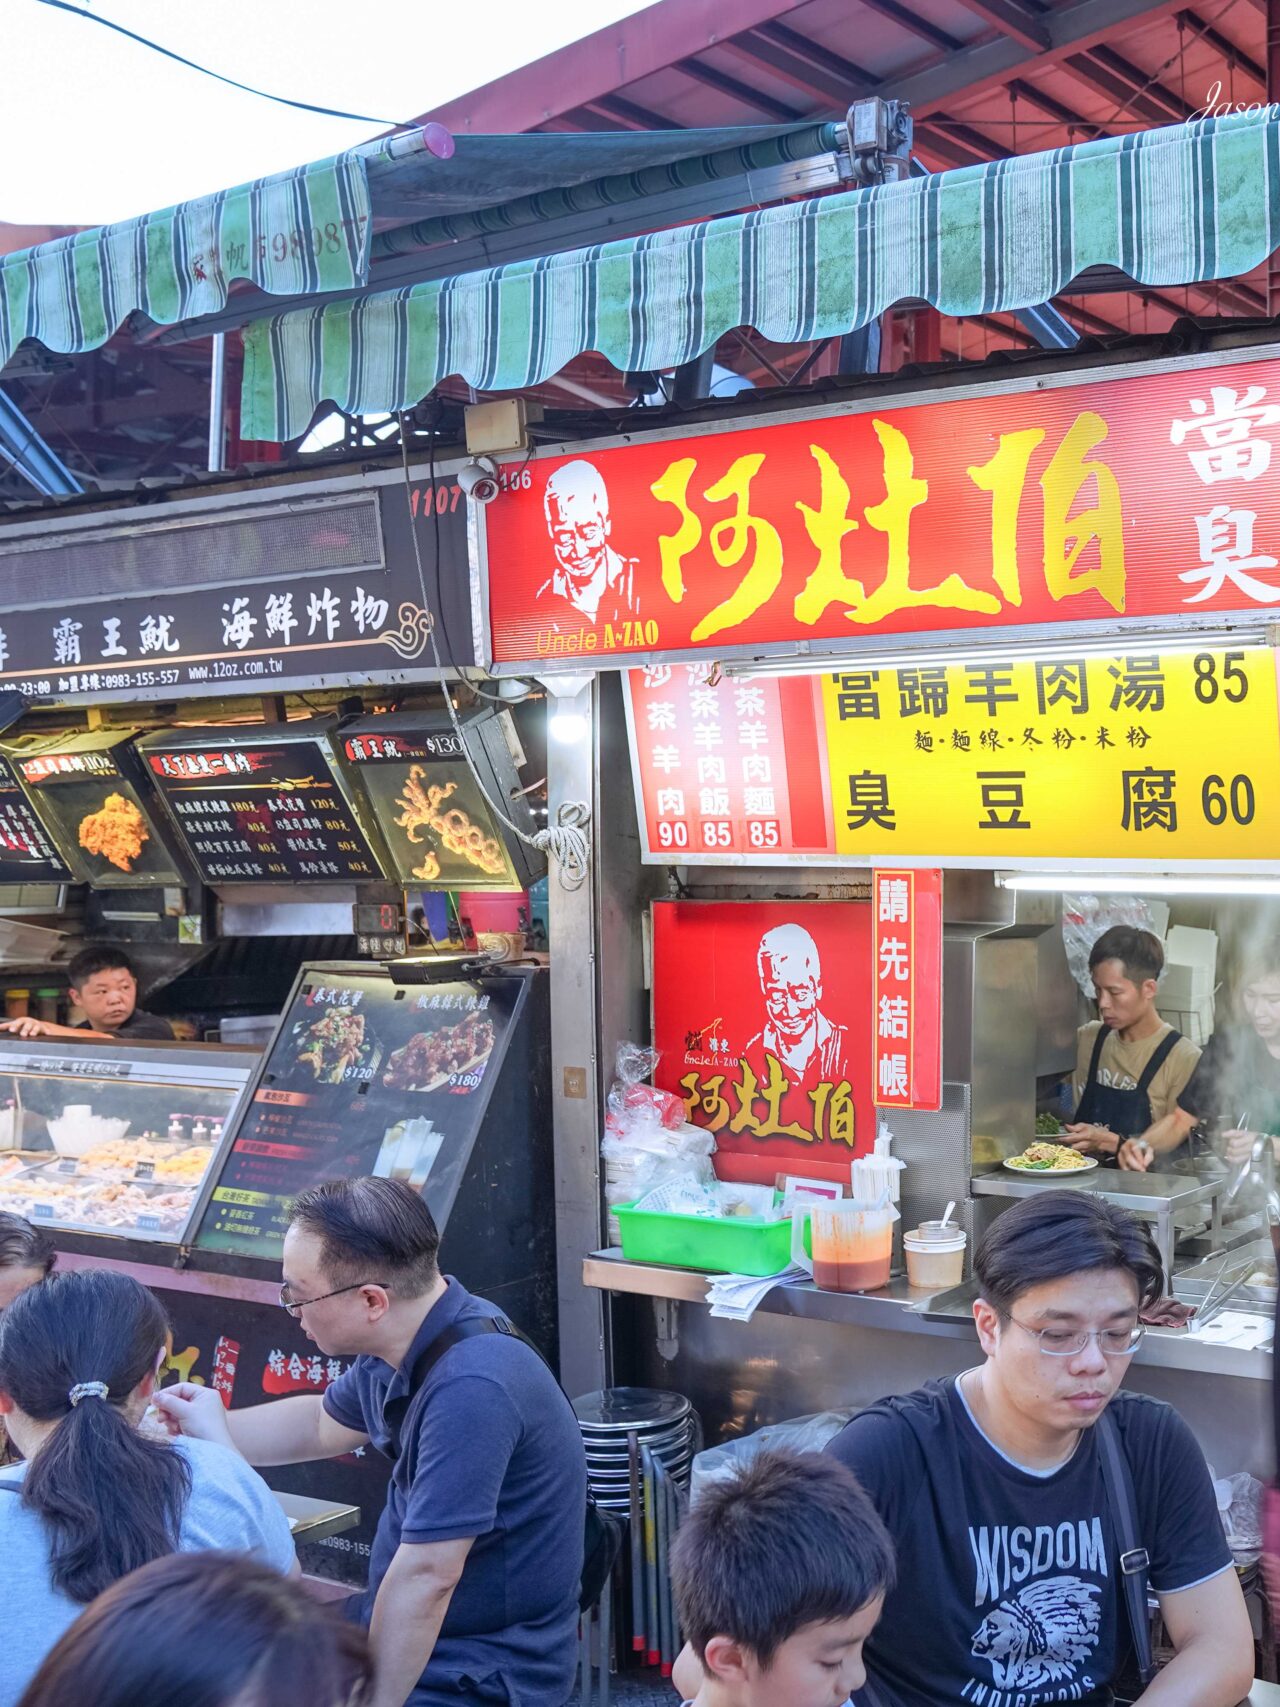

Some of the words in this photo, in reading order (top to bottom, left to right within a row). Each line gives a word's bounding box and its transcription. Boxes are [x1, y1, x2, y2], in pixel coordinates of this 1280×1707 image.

[411, 484, 461, 518] 1107
[651, 411, 1126, 641] 阿灶伯
[53, 614, 180, 664] 霸王魷
[221, 586, 390, 649] 海鮮炸物
[536, 629, 597, 654] Uncle
[188, 657, 283, 680] www.12oz.com.tw
[831, 655, 1166, 721] 當歸羊肉湯
[1193, 651, 1250, 705] 85
[641, 662, 686, 817] 沙茶羊肉
[685, 661, 731, 817] 沙茶羊肉飯
[846, 766, 1179, 833] 臭豆腐
[1201, 774, 1256, 826] 60
[658, 821, 688, 848] 90
[702, 821, 732, 848] 85
[749, 820, 780, 848] 85
[878, 878, 909, 1098] 請先結帳
[344, 1066, 373, 1079] $120
[449, 1072, 479, 1086] $180
[679, 1052, 856, 1147] 阿灶伯
[268, 1347, 350, 1384] 綜合海鮮
[968, 1516, 1108, 1608] WISDOM
